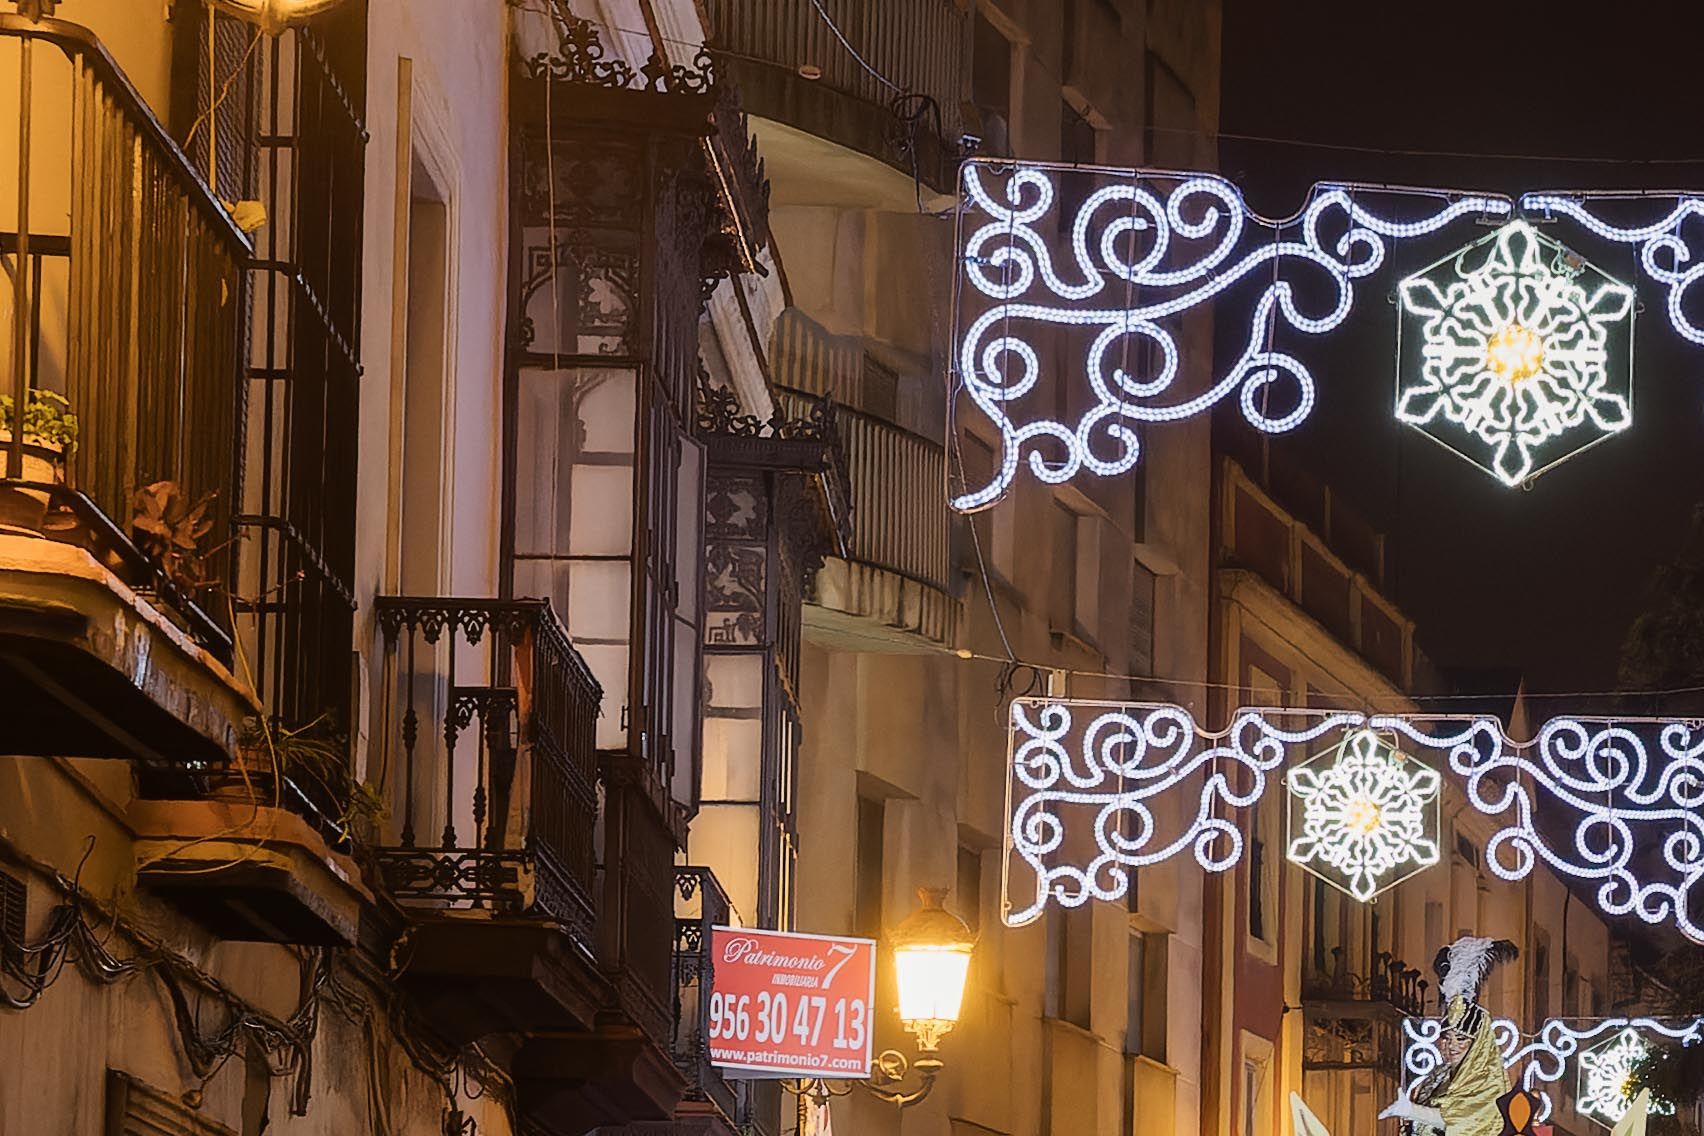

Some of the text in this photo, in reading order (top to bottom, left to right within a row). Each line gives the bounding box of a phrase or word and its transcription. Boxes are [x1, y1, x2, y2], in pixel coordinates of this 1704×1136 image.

[723, 937, 858, 989] Patrimonio 7
[709, 991, 865, 1050] 956 30 47 13
[710, 1047, 861, 1070] www.patrimonio7.com
